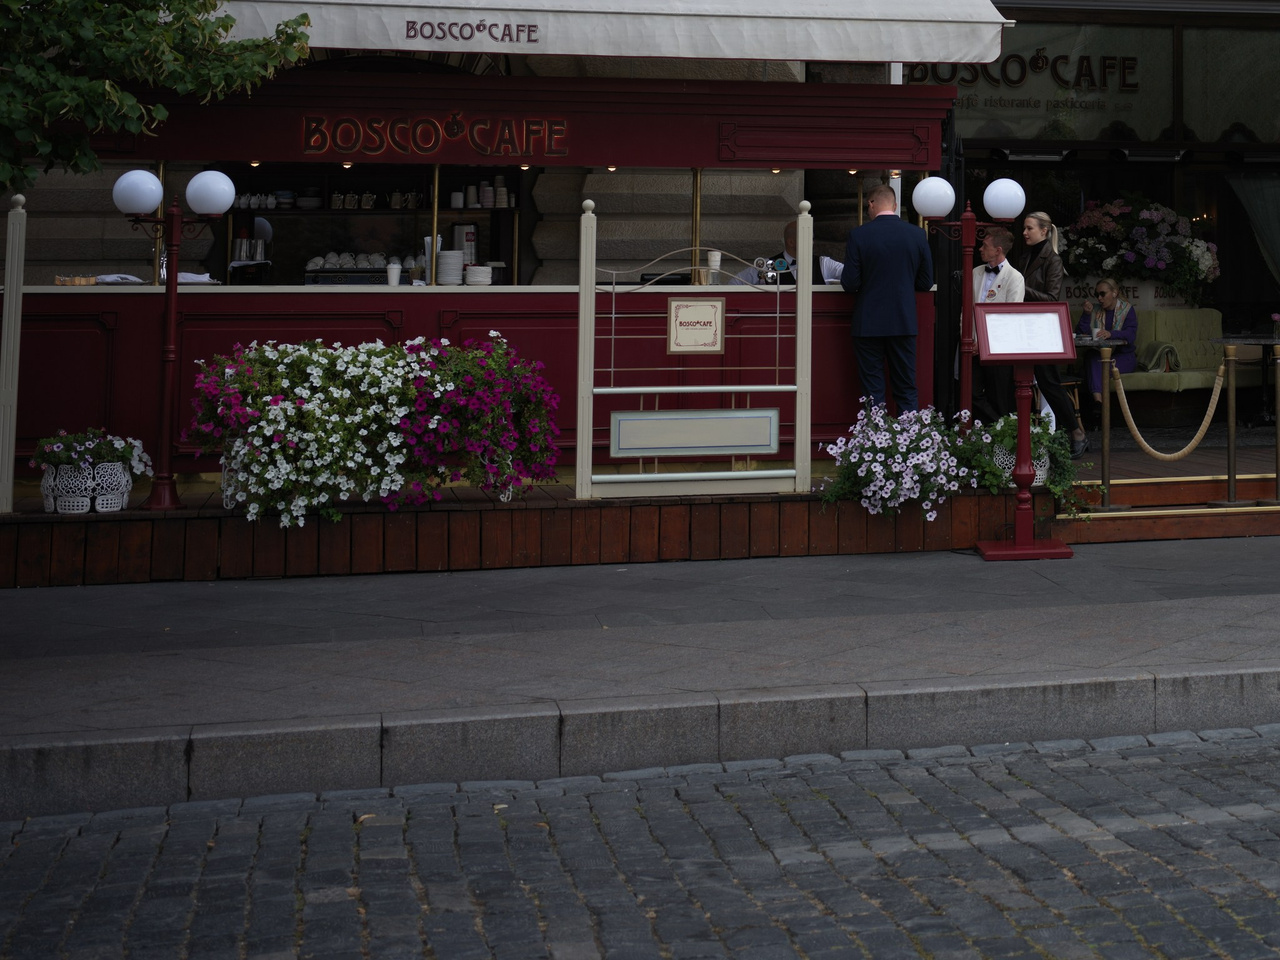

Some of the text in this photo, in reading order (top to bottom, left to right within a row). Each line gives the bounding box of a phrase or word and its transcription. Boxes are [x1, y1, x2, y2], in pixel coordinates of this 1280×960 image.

[405, 20, 540, 43] BOSCO CAFE
[1050, 54, 1140, 91] CAFE
[984, 95, 1041, 109] ristorante
[1046, 96, 1107, 112] pasticceria
[303, 116, 569, 157] BOSCO CAFE
